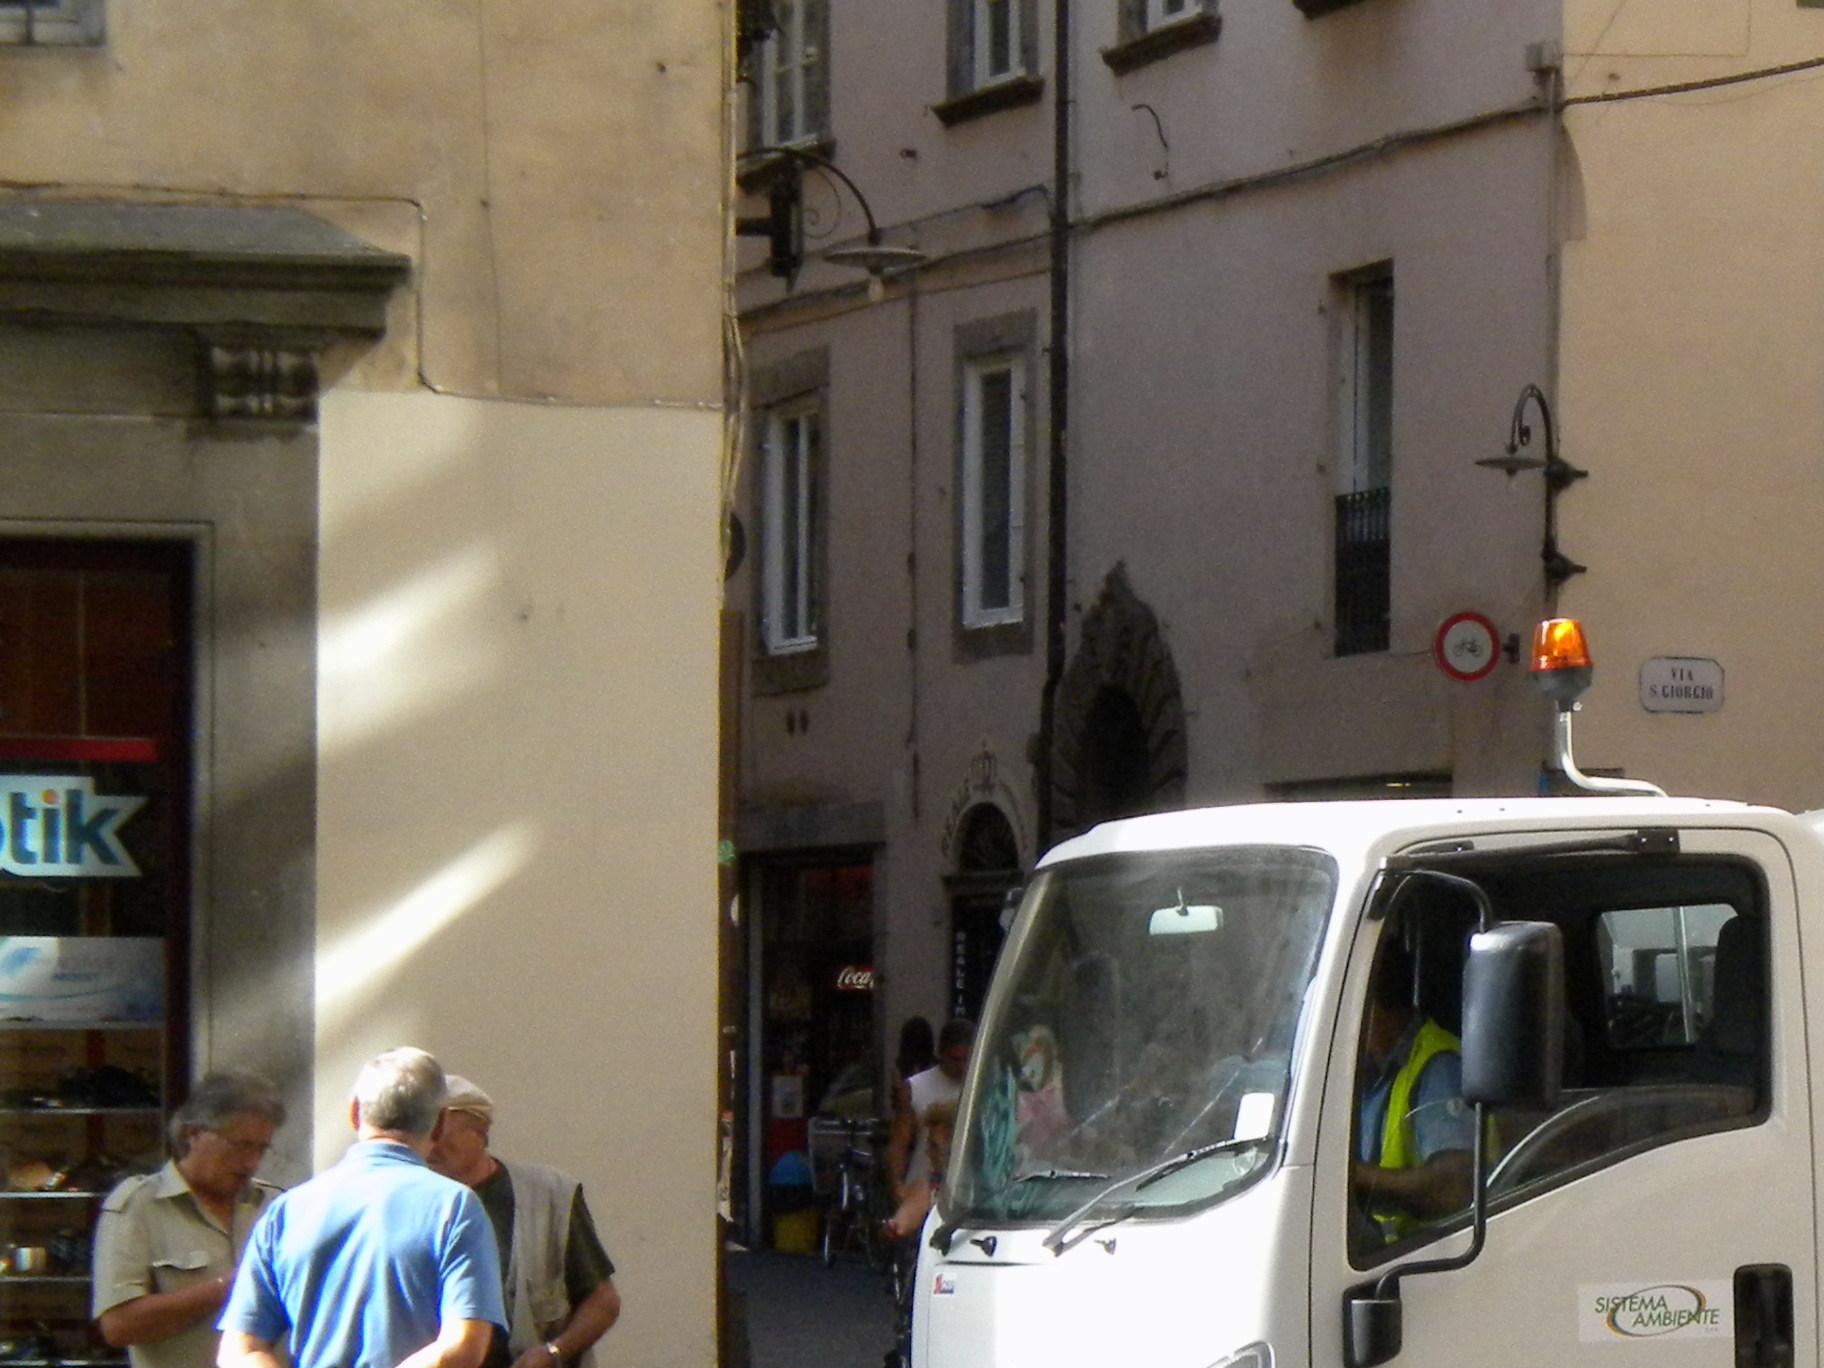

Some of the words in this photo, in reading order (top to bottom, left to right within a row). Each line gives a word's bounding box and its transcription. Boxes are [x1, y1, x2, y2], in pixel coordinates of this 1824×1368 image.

[1671, 667, 1694, 681] VIA
[1662, 685, 1714, 700] GIORGIO
[0, 789, 120, 865] tik
[1594, 1295, 1668, 1314] SISTEMA
[1632, 1308, 1720, 1328] AMBIENTE
